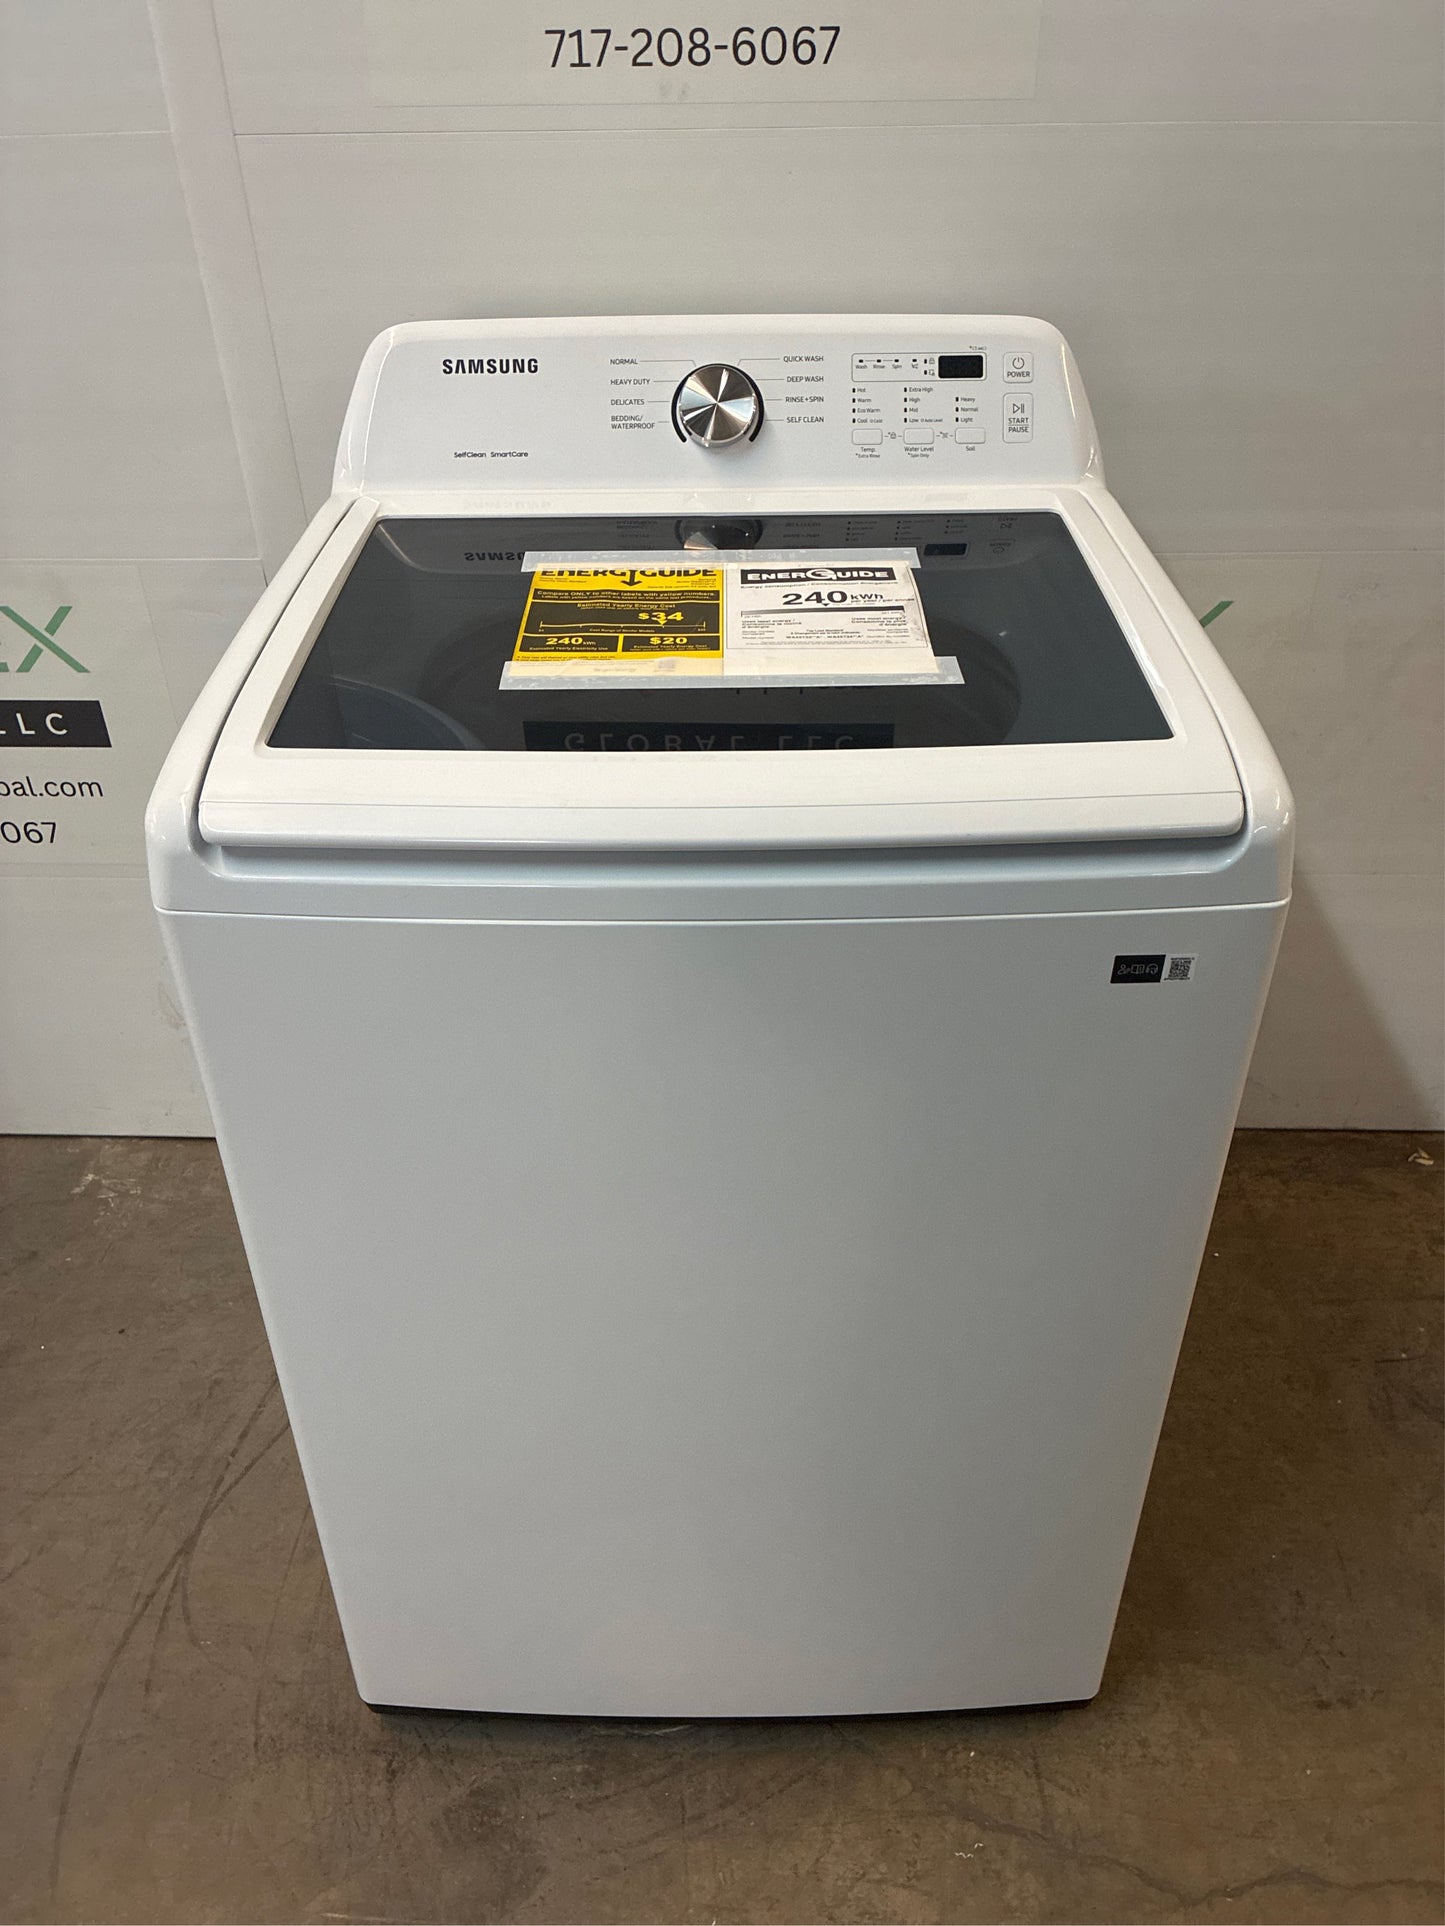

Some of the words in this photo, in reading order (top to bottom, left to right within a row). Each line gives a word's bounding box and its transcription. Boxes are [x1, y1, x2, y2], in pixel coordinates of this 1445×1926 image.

[544, 25, 841, 68] 717-208-6067
[783, 355, 804, 363] QUICK
[442, 358, 539, 375] SAMSUNG
[610, 398, 645, 406] DELICATES
[748, 568, 889, 581] ENERGUIDE
[783, 590, 848, 605] 240
[638, 611, 684, 622] $34
[545, 637, 583, 645] 240
[650, 636, 688, 645] $20
[0, 821, 57, 844] 067
